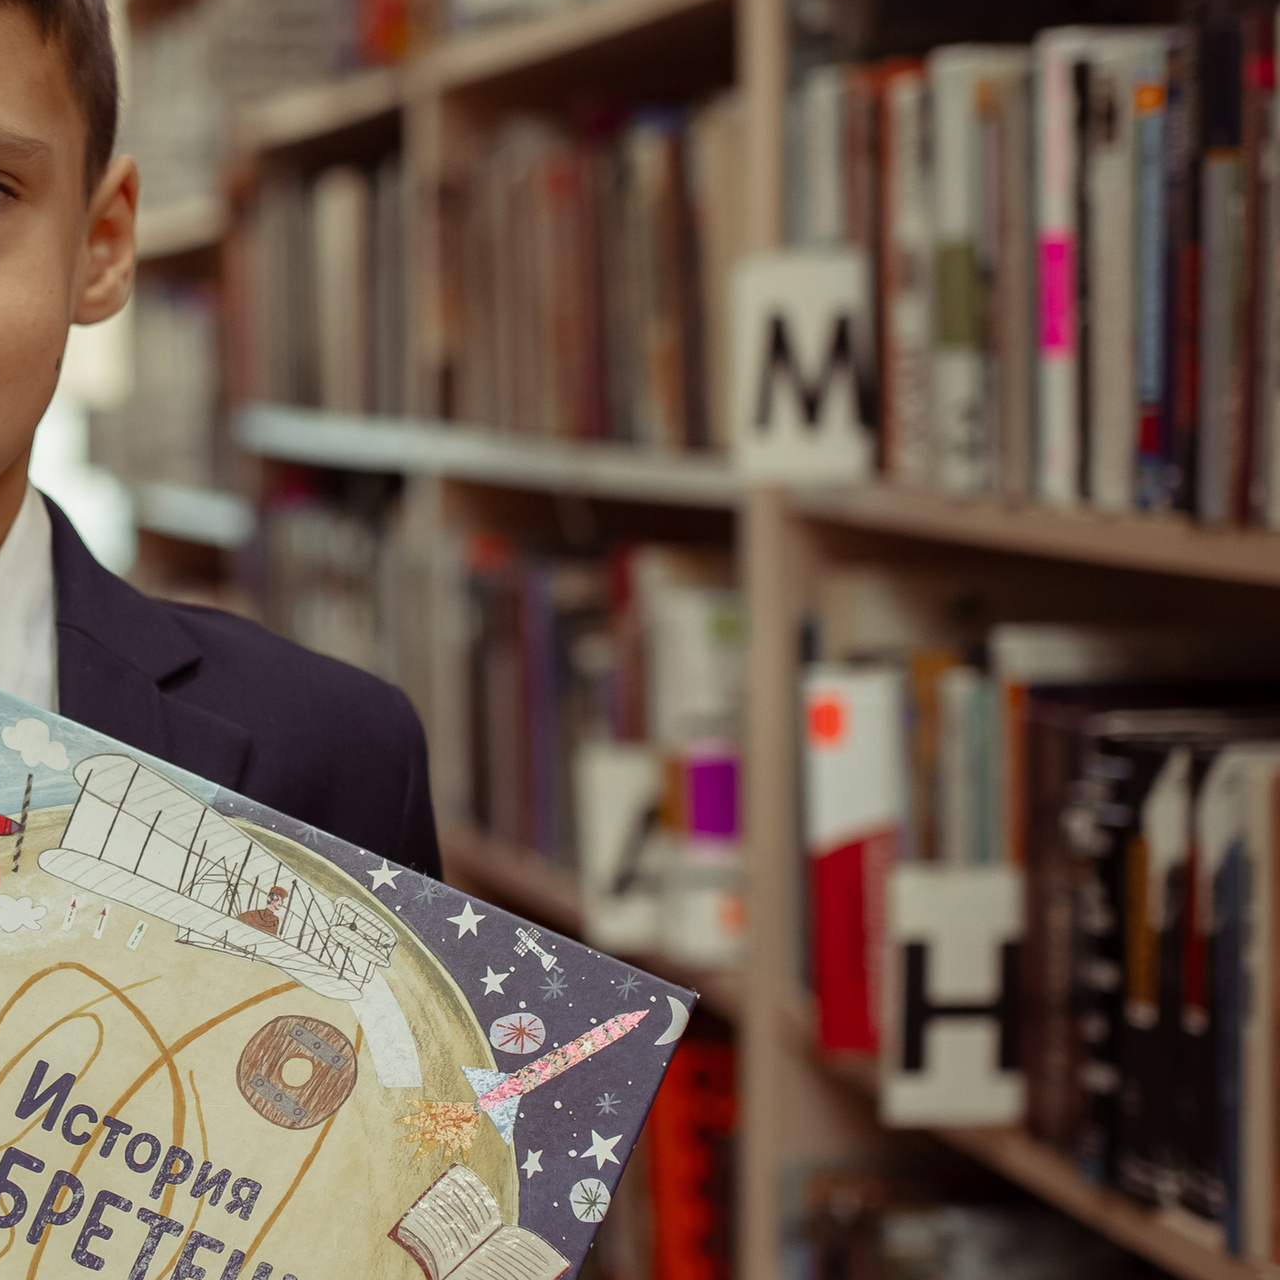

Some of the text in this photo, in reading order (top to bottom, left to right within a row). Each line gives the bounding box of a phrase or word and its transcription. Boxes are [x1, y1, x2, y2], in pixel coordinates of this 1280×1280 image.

[754, 310, 878, 434] М
[900, 941, 1026, 1074] Н
[14, 1059, 263, 1222] История
